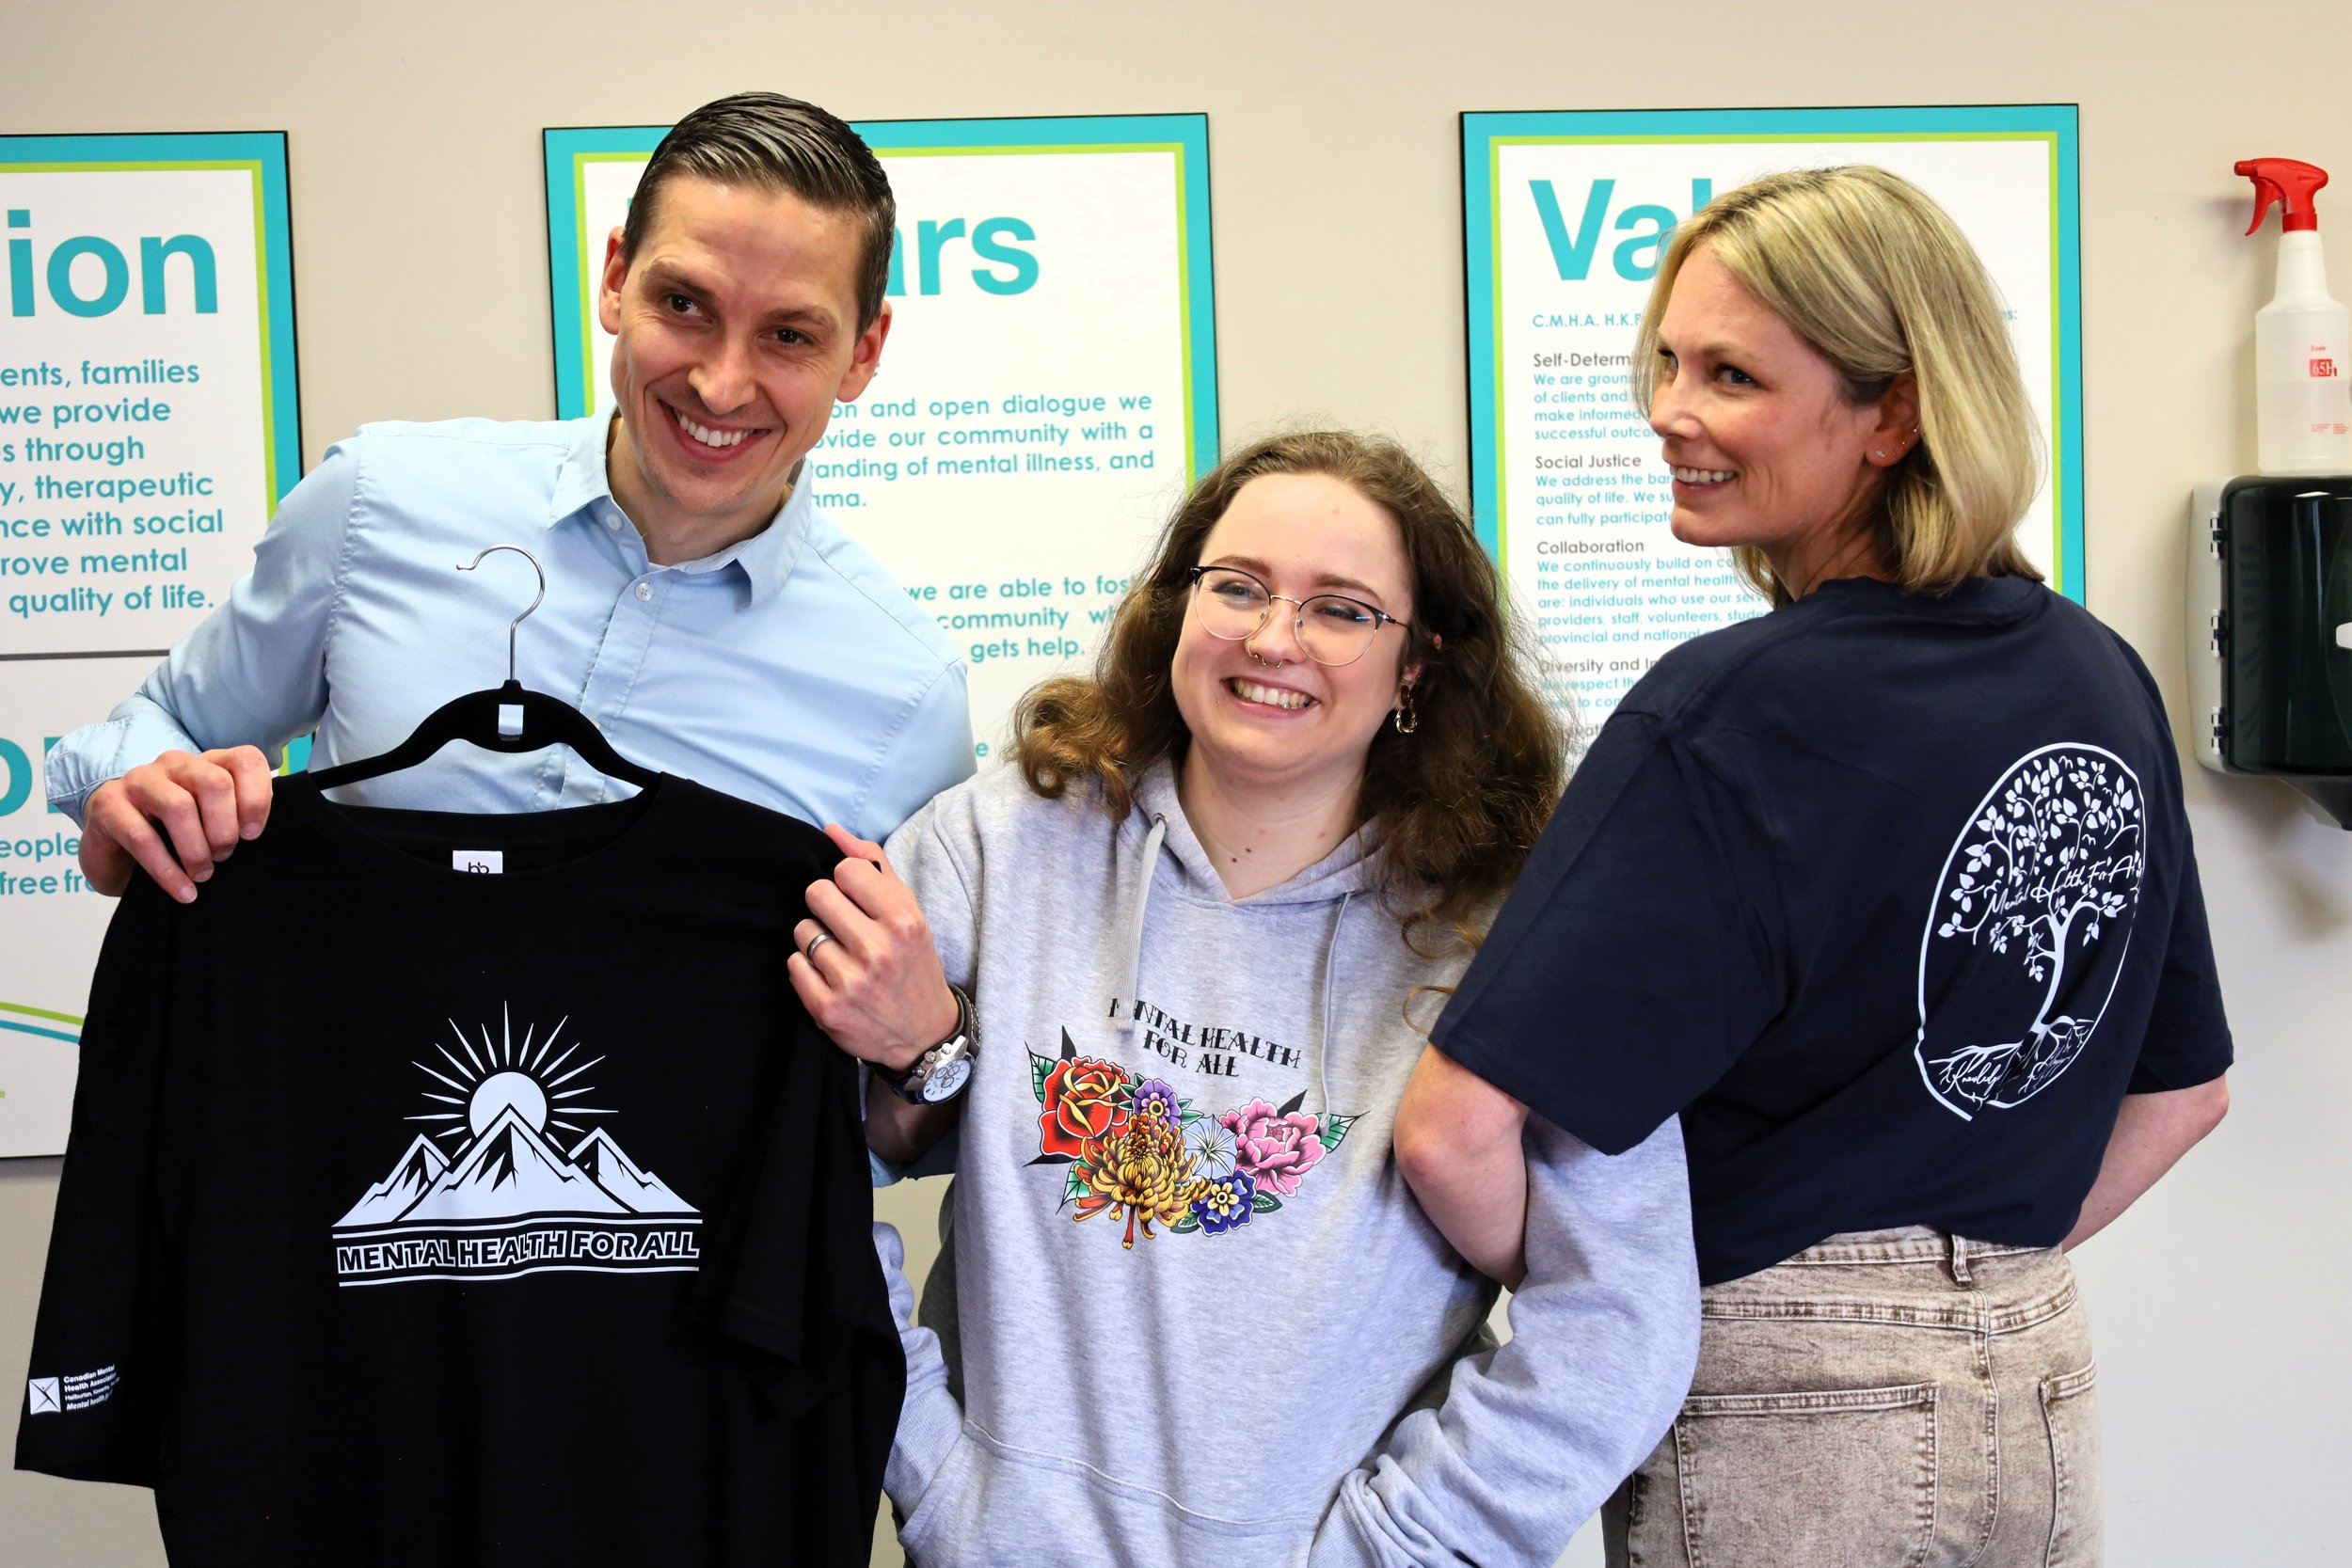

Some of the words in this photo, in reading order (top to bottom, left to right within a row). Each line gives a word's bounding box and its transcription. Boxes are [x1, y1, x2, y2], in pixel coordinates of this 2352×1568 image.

[8, 209, 218, 317] ion
[1533, 313, 1599, 327] C.M.H.A.
[0, 361, 72, 388] ents,
[81, 358, 200, 385] families
[1534, 373, 1555, 385] We
[1560, 374, 1583, 385] are
[1534, 391, 1547, 404] of
[1551, 391, 1596, 403] clients
[1600, 389, 1628, 402] and
[0, 404, 41, 423] we
[53, 397, 171, 429] provide
[870, 398, 916, 418] and
[929, 399, 990, 420] open
[1002, 394, 1107, 420] dialogue
[1119, 395, 1153, 410] we
[1534, 409, 1575, 421] make
[889, 432, 926, 447] our
[937, 423, 1070, 448] community
[1081, 420, 1127, 441] with
[1138, 425, 1153, 439] a
[1534, 426, 1607, 439] successful
[0, 443, 15, 463] s
[25, 436, 144, 466] through
[907, 456, 929, 476] of
[938, 454, 1017, 476] mental
[1025, 453, 1101, 472] illness,
[1109, 450, 1154, 470] and
[1535, 454, 1583, 469] Social
[1588, 453, 1642, 468] Justice
[35, 471, 214, 503] therapeutic
[1535, 475, 1557, 486] We
[1563, 473, 1616, 486] address
[1621, 472, 1643, 484] the
[1535, 493, 1582, 507] quality
[1588, 491, 1600, 504] of
[1605, 491, 1629, 503] life.
[1633, 491, 1655, 503] We
[61, 511, 122, 536] with
[133, 508, 224, 534] social
[1536, 515, 1564, 526] can
[1568, 512, 1596, 527] fully
[1537, 539, 1645, 555] Collaboration
[1, 557, 69, 576] rove
[81, 547, 187, 574] mental
[1537, 562, 1560, 573] We
[1564, 559, 1651, 572] continuously
[1657, 557, 1691, 569] build
[1695, 559, 1712, 568] on
[904, 584, 937, 601] we
[949, 583, 988, 600] are
[999, 578, 1053, 598] able
[1064, 577, 1086, 595] to
[1537, 578, 1559, 590] the
[1564, 577, 1619, 591] delivery
[1625, 575, 1637, 587] of
[1642, 575, 1690, 588] mental
[9, 587, 113, 619] quality
[124, 585, 152, 610] of
[163, 584, 215, 609] life.
[1538, 597, 1565, 609] are:
[1569, 594, 1644, 608] individuals
[1648, 593, 1677, 605] who
[1681, 594, 1706, 605] use
[1709, 594, 1731, 605] our
[936, 608, 1069, 630] community
[1538, 613, 1605, 628] providers,
[1612, 612, 1642, 626] staff,
[1648, 611, 1722, 625] volunteers,
[1538, 632, 1608, 646] provincial
[1613, 631, 1639, 642] and
[1644, 629, 1700, 641] national
[971, 639, 1019, 663] gets
[1028, 638, 1085, 658] help.
[1538, 657, 1603, 674] Diversity
[1610, 657, 1640, 671] and
[1565, 677, 1617, 691] respect
[1578, 696, 1590, 707] to
[0, 870, 57, 895] free
[1107, 997, 1196, 1047] MNTAL
[1200, 1026, 1302, 1070] HEALTH
[1142, 1028, 1187, 1069] FOR
[1196, 1053, 1240, 1078] ALL
[337, 1239, 456, 1275] MENTAL
[457, 1229, 567, 1268] HEALTH
[569, 1230, 644, 1260] FOR
[636, 1230, 700, 1259] ALL
[63, 1372, 97, 1384] Canadian
[64, 1382, 89, 1393] Health
[66, 1399, 90, 1411] Mental
